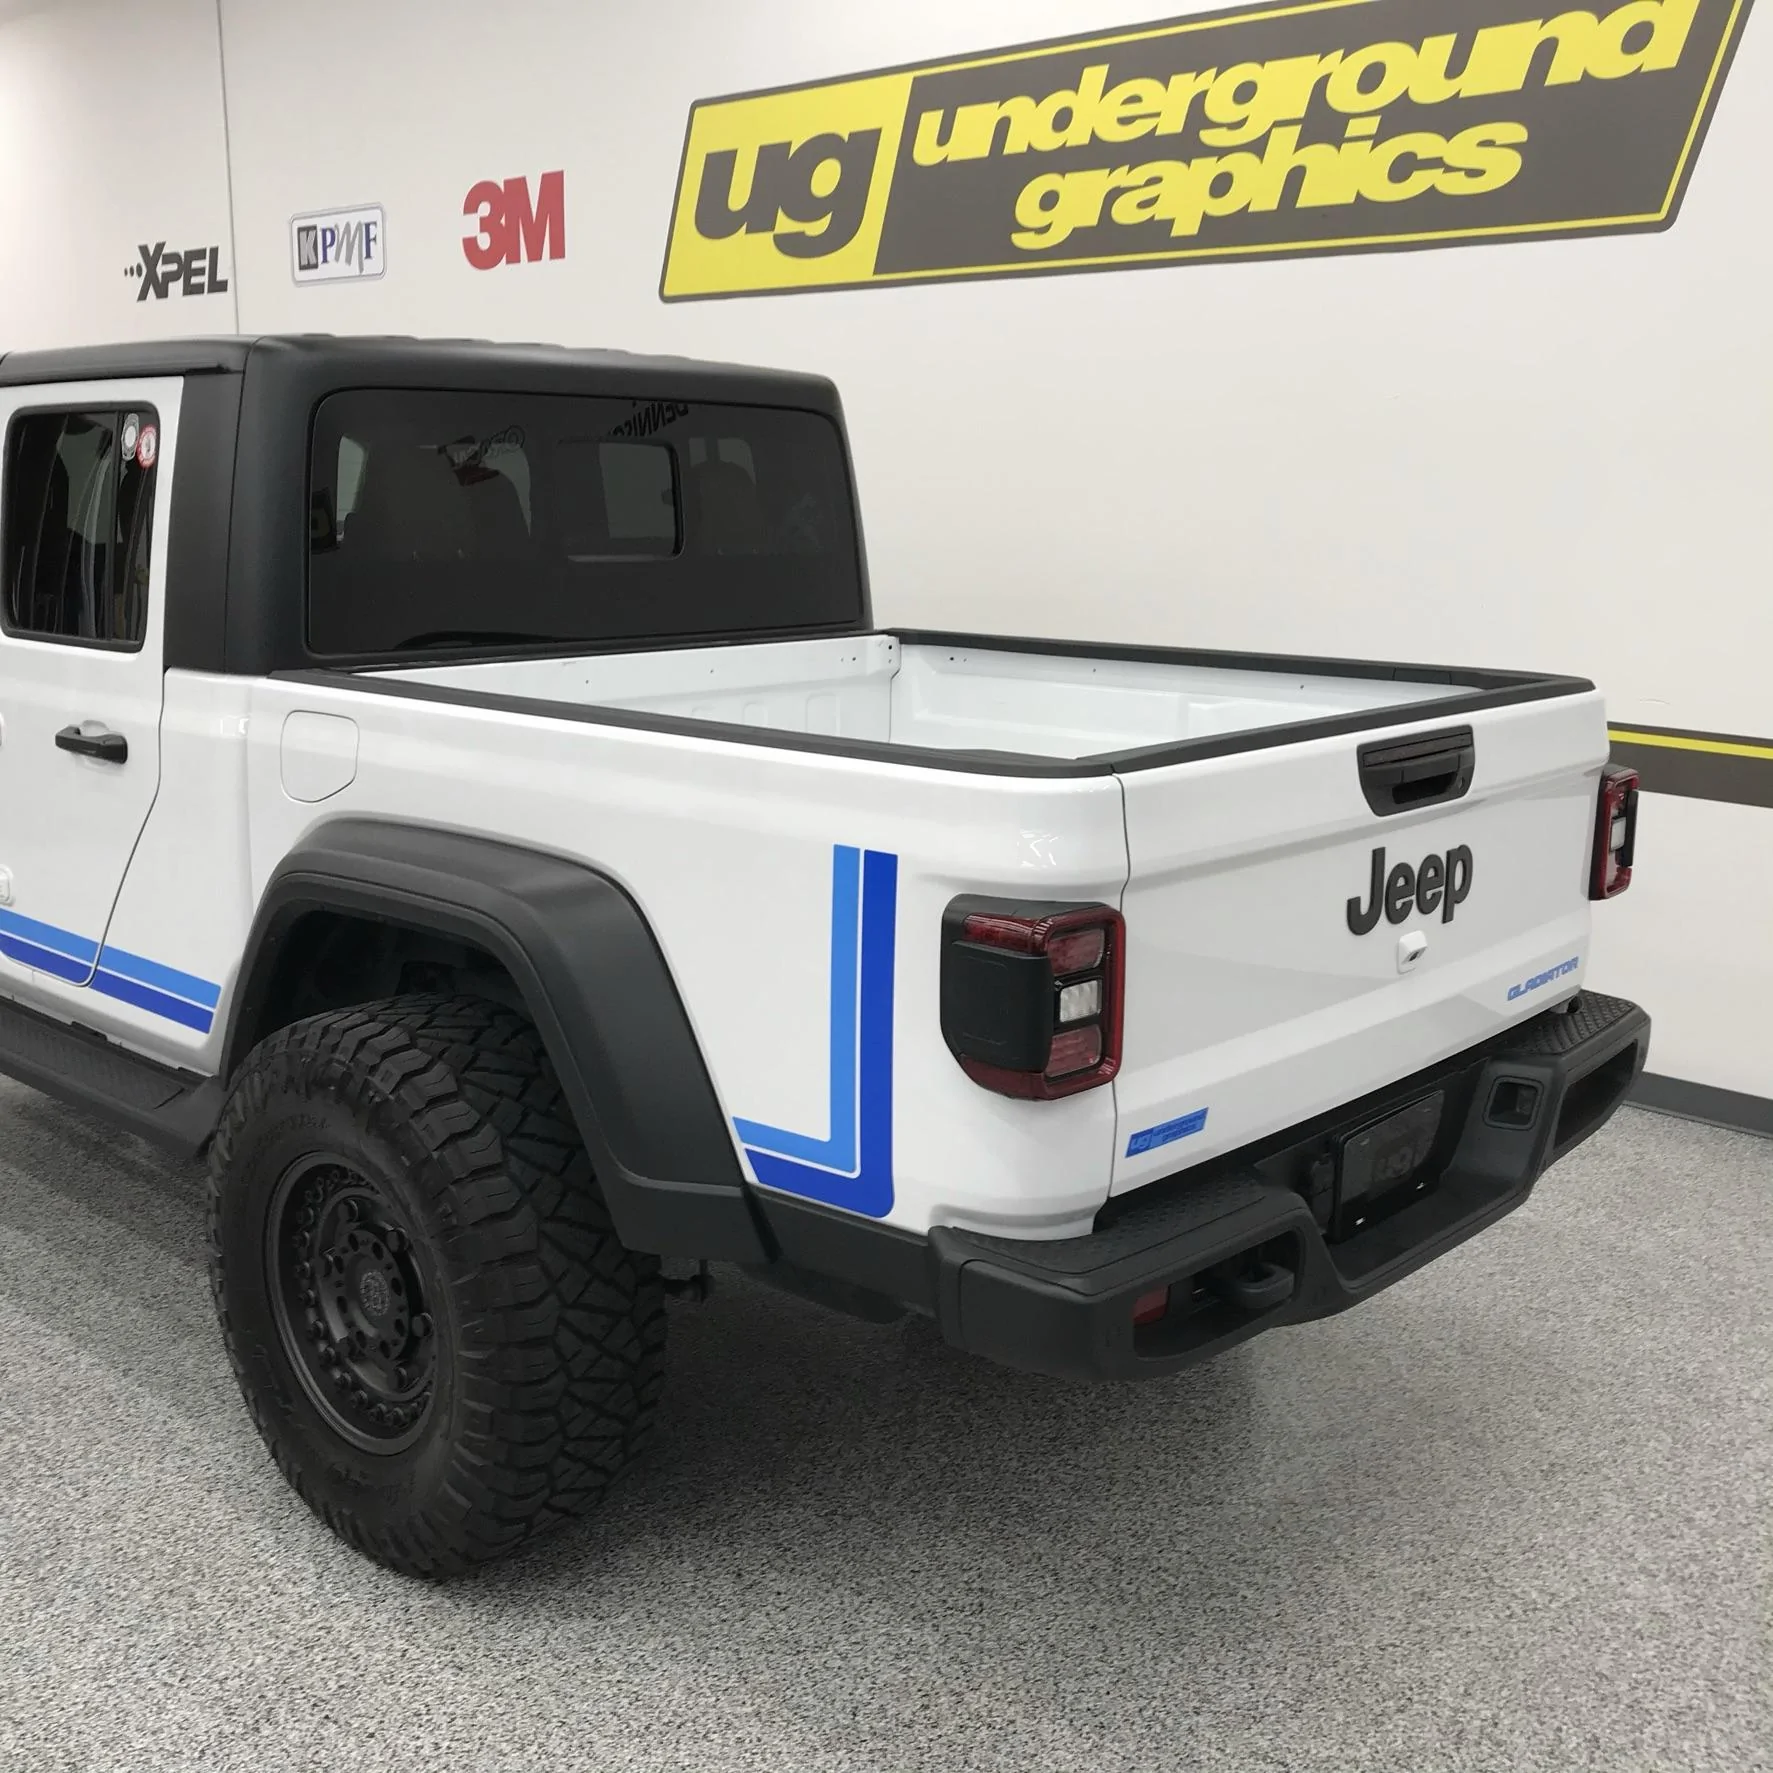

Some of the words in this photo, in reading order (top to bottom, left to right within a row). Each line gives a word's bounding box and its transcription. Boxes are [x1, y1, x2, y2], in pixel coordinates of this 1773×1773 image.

[913, 0, 1700, 166] underground
[462, 170, 566, 271] 3M
[695, 128, 882, 258] ug
[1011, 121, 1528, 250] graphics
[137, 241, 229, 301] XPEL
[297, 220, 377, 274] KPMF
[1346, 844, 1474, 936] Jeep
[1507, 956, 1579, 1001] GLADIATOR
